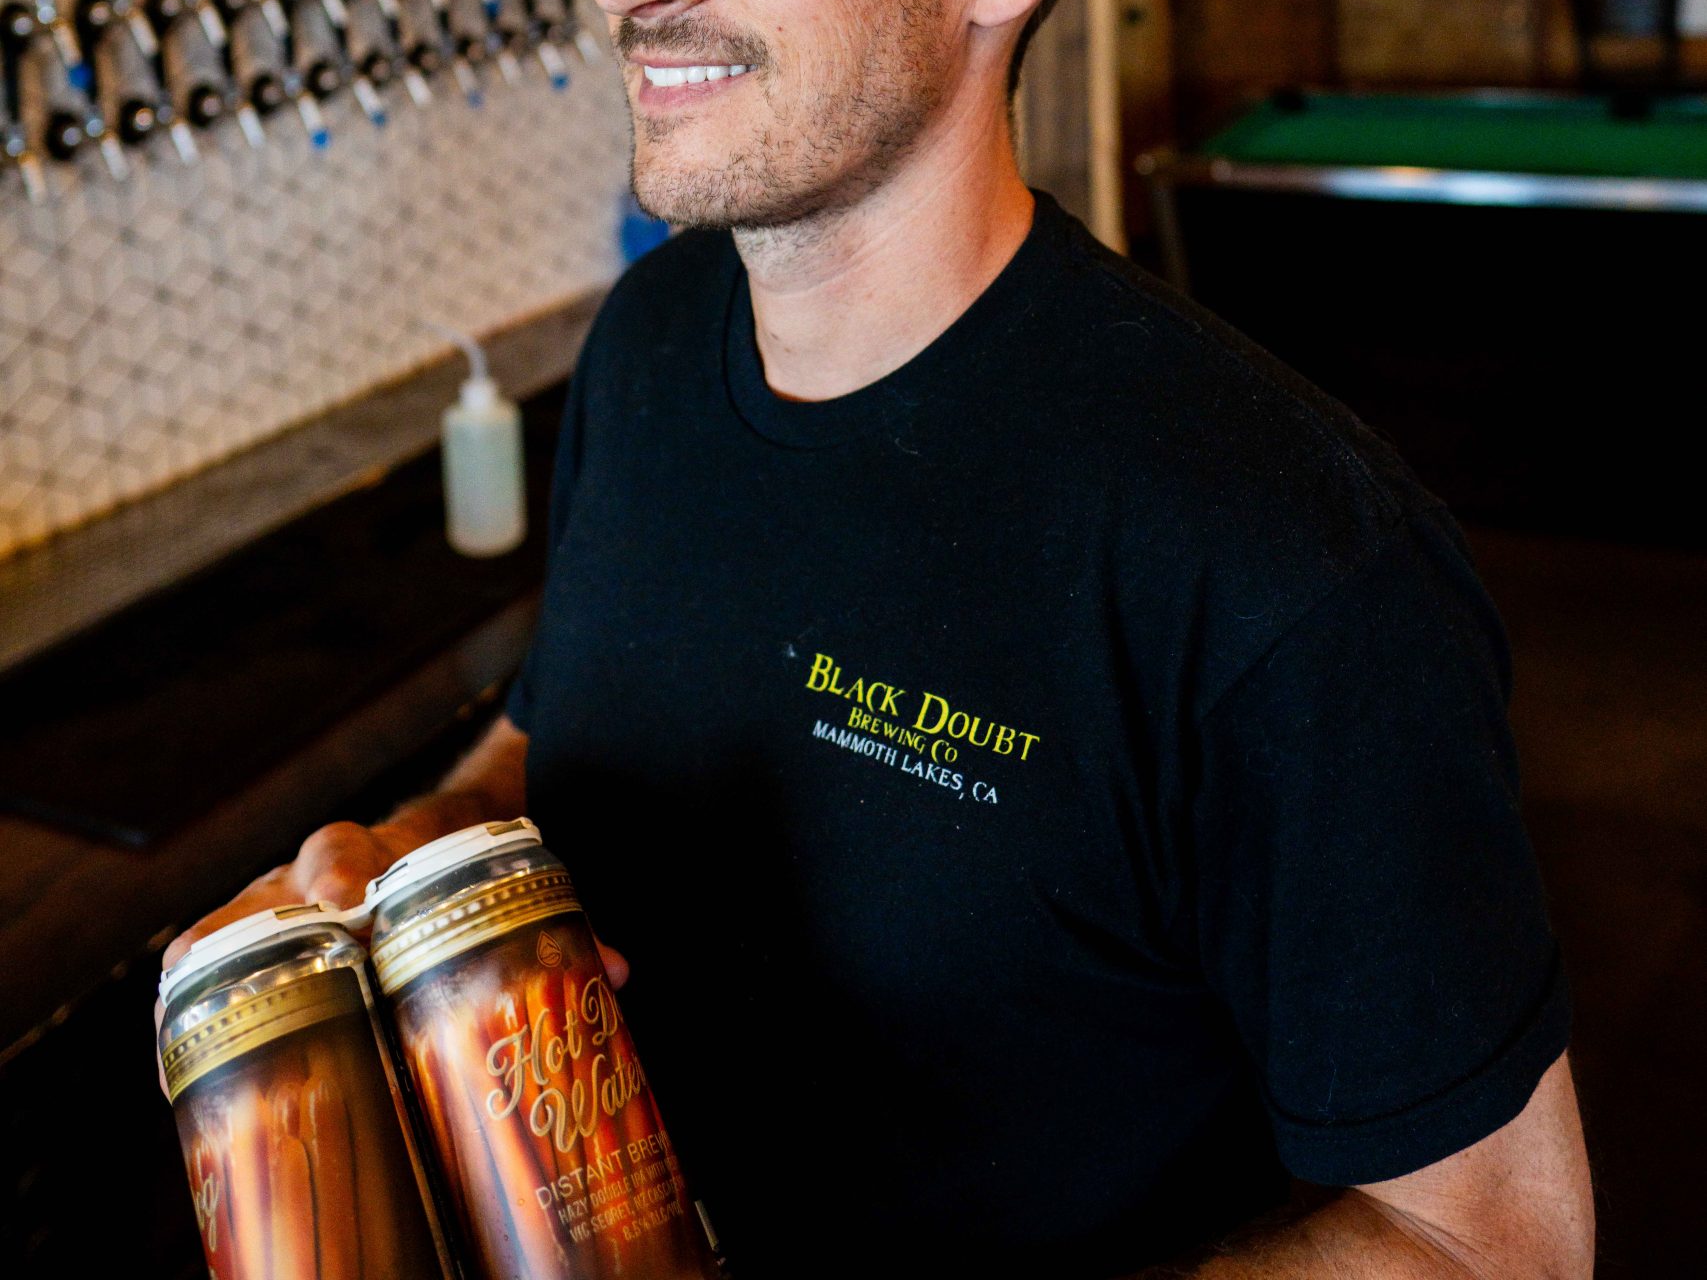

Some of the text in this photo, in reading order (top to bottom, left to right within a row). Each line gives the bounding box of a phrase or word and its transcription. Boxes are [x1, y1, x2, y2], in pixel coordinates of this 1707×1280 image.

[806, 652, 1041, 761] BLACK DOUBT
[847, 706, 926, 755] BREWING
[812, 719, 998, 805] MAMMOTH LAKES, CA
[485, 1007, 583, 1121] Hot
[535, 1149, 623, 1210] DISTANT
[557, 1197, 590, 1226] HAZY
